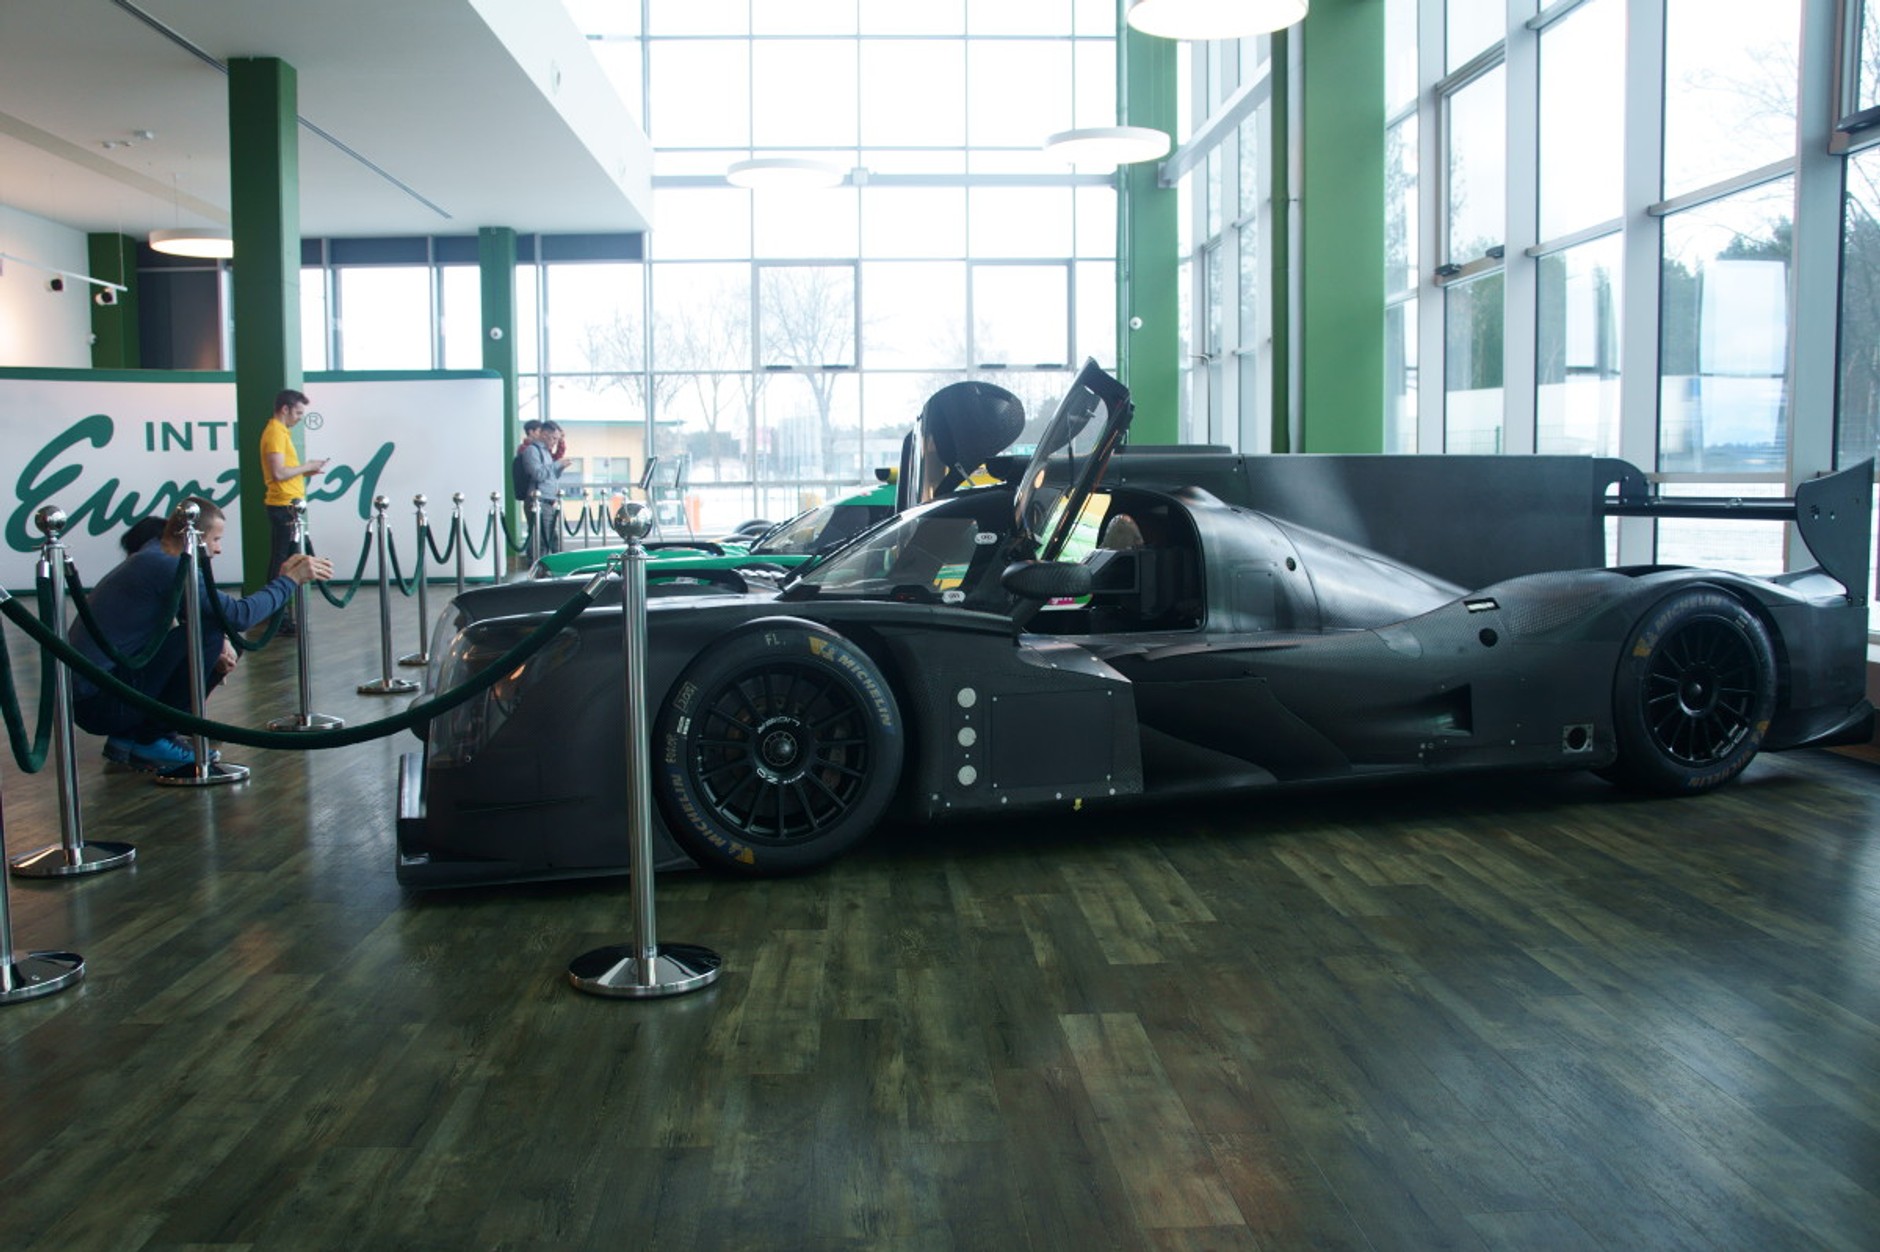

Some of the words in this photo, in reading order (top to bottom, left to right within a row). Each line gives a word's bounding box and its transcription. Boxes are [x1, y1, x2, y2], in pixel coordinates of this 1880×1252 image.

[145, 421, 239, 452] INT
[838, 654, 892, 727] MICHELIN
[672, 774, 726, 848] MICHELIN
